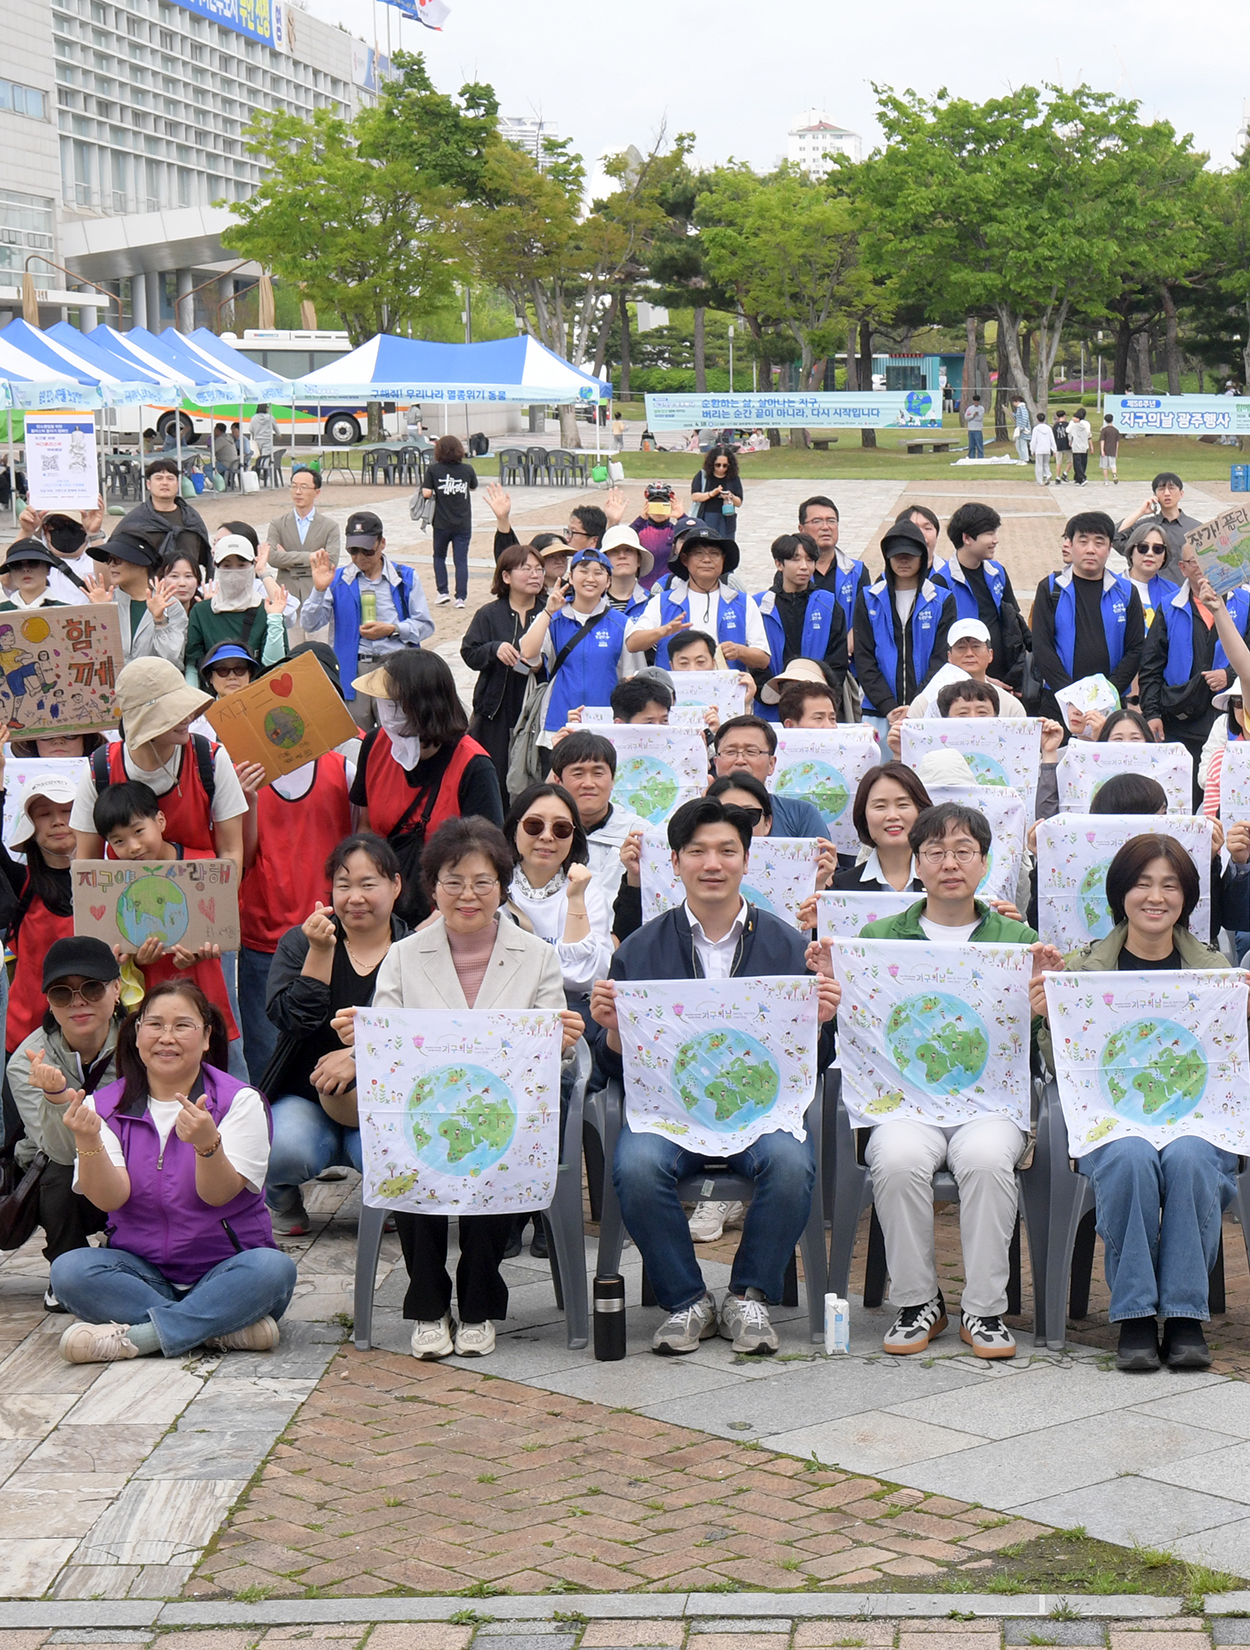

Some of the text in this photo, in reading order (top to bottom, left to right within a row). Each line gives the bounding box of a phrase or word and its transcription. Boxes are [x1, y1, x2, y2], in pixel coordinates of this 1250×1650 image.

[371, 389, 402, 399] 구해줘!
[406, 389, 444, 400] 우리나라
[447, 390, 484, 400] 멸종위기
[488, 390, 506, 400] 동물
[702, 398, 821, 408] 순환하는 삶, 살아나는 지구,
[1236, 404, 1250, 412] 함께
[702, 408, 880, 419] 버리는 순간 끝이 아니라, 다시 시작입니다
[1121, 412, 1175, 428] 지구의날
[1177, 411, 1231, 429] 광주행사
[1187, 520, 1221, 547] 잘가!
[216, 699, 248, 722] 지구
[77, 862, 231, 893] 지구야 사랑해
[917, 972, 945, 982] 지구의날
[1132, 998, 1161, 1008] 지구의날
[702, 1009, 732, 1019] 지구의날
[443, 1043, 473, 1053] 지구의날
